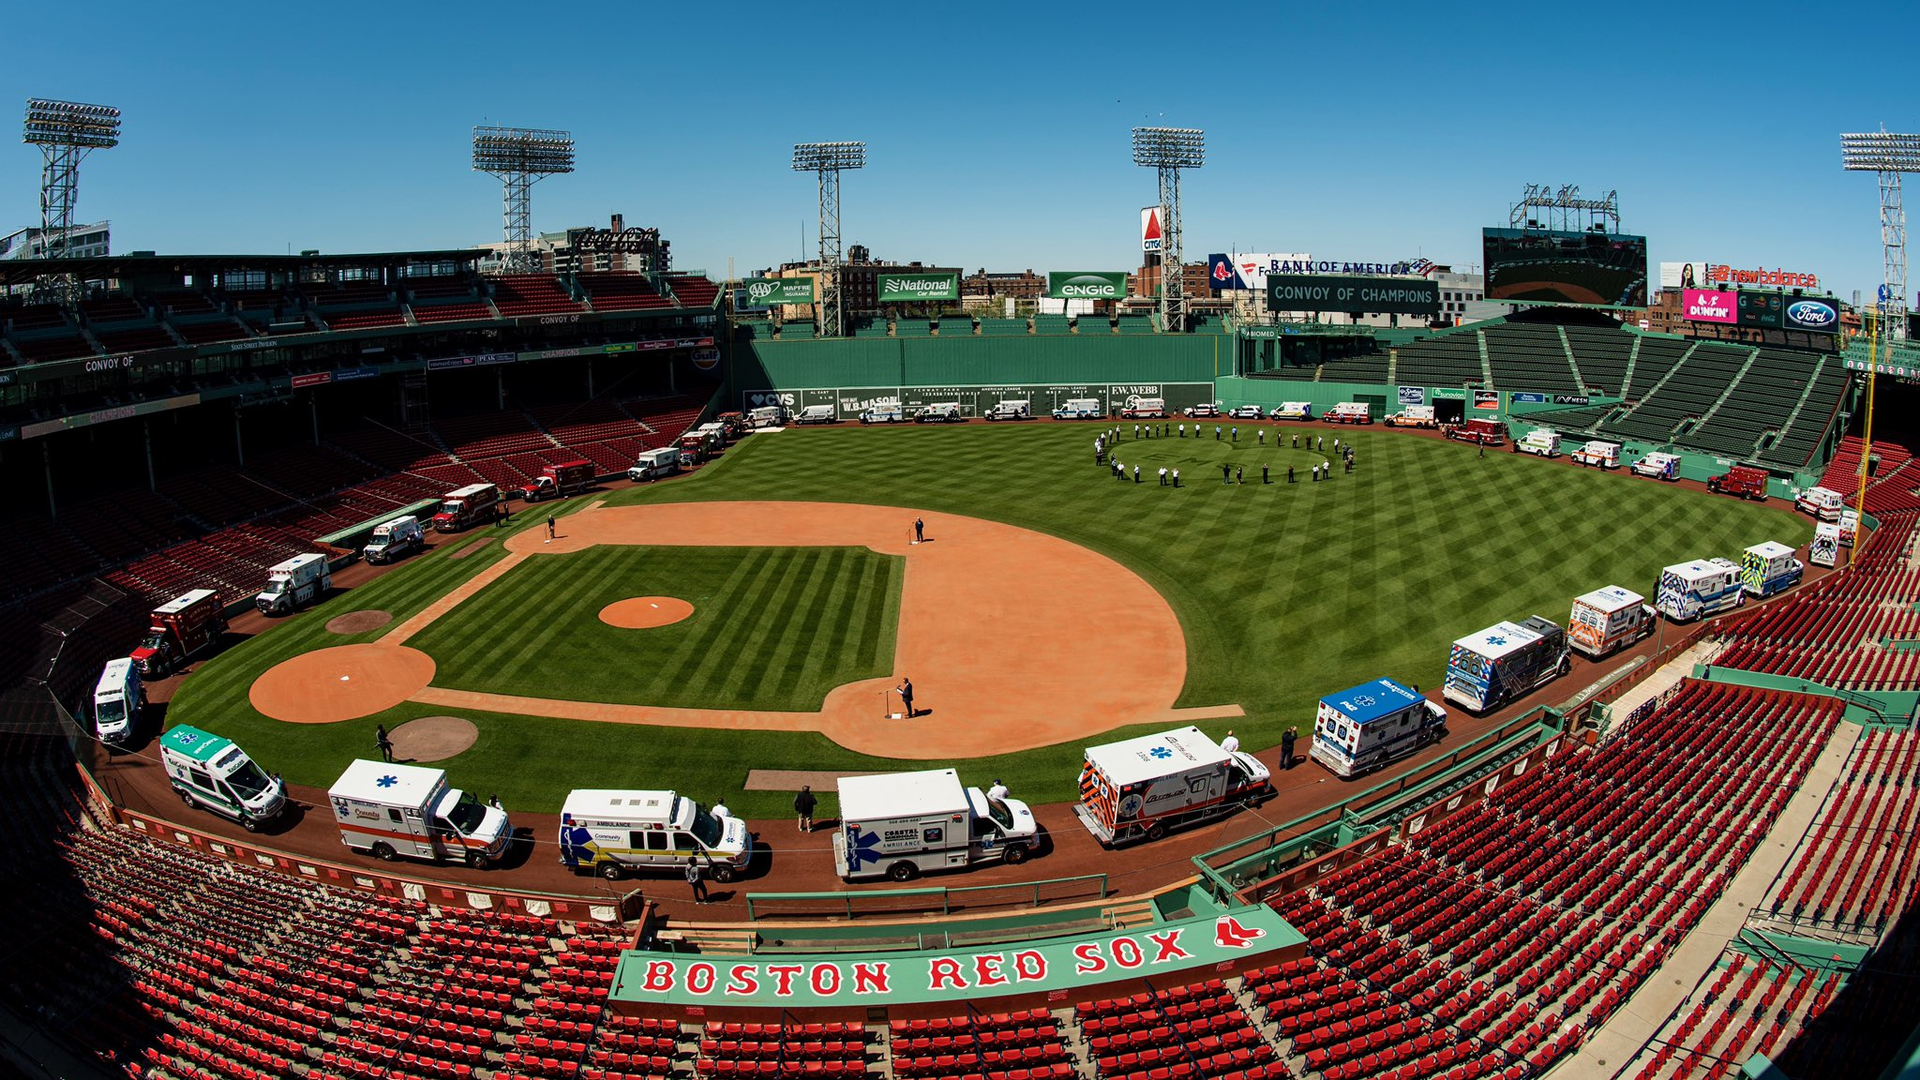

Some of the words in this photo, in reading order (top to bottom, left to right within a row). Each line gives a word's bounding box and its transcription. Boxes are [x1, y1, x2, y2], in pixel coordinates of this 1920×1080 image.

[1510, 183, 1553, 224] John
[1551, 184, 1621, 223] Hancock
[1270, 259, 1315, 272] BANK
[1319, 261, 1337, 272] OF
[1342, 262, 1409, 275] AMERICA
[750, 284, 770, 294] AAA
[900, 279, 951, 291] National
[1275, 286, 1330, 300] CONVOY
[1337, 287, 1355, 300] OF
[1361, 288, 1432, 303] CHAMPIONS
[1690, 306, 1729, 318] DUNKIN'
[1796, 304, 1826, 322] Ford
[540, 316, 568, 324] CONVOY
[541, 348, 580, 358] CHAMPIONS
[693, 351, 718, 360] Gulf
[85, 358, 119, 372] CONVOY
[122, 356, 134, 367] OF
[1132, 385, 1158, 394] WEBB
[765, 393, 795, 405] CVS
[90, 405, 136, 424] CHAMPIONS
[355, 808, 380, 818] County
[594, 833, 621, 841] Community
[884, 828, 919, 836] COASTAL
[883, 840, 920, 848] AMBULANCE
[640, 959, 893, 997] BOSTON
[927, 949, 1049, 991] RED
[1073, 927, 1196, 976] SOX
